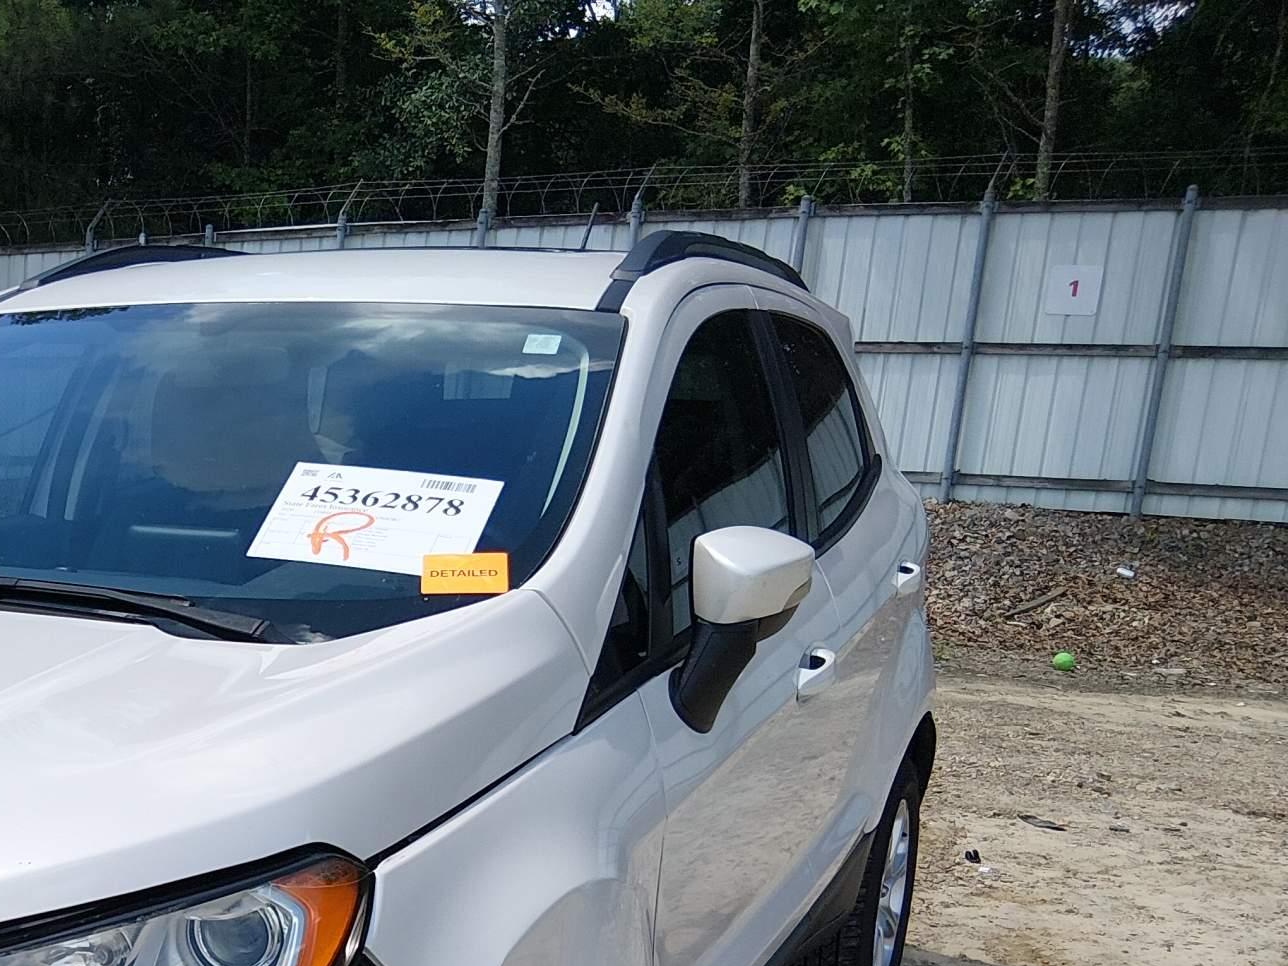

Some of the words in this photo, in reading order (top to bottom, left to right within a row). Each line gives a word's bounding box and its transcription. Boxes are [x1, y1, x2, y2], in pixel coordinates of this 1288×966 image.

[1069, 280, 1079, 297] 1
[300, 484, 465, 517] 45362878
[308, 511, 375, 561] R
[429, 568, 498, 579] DETAILED
